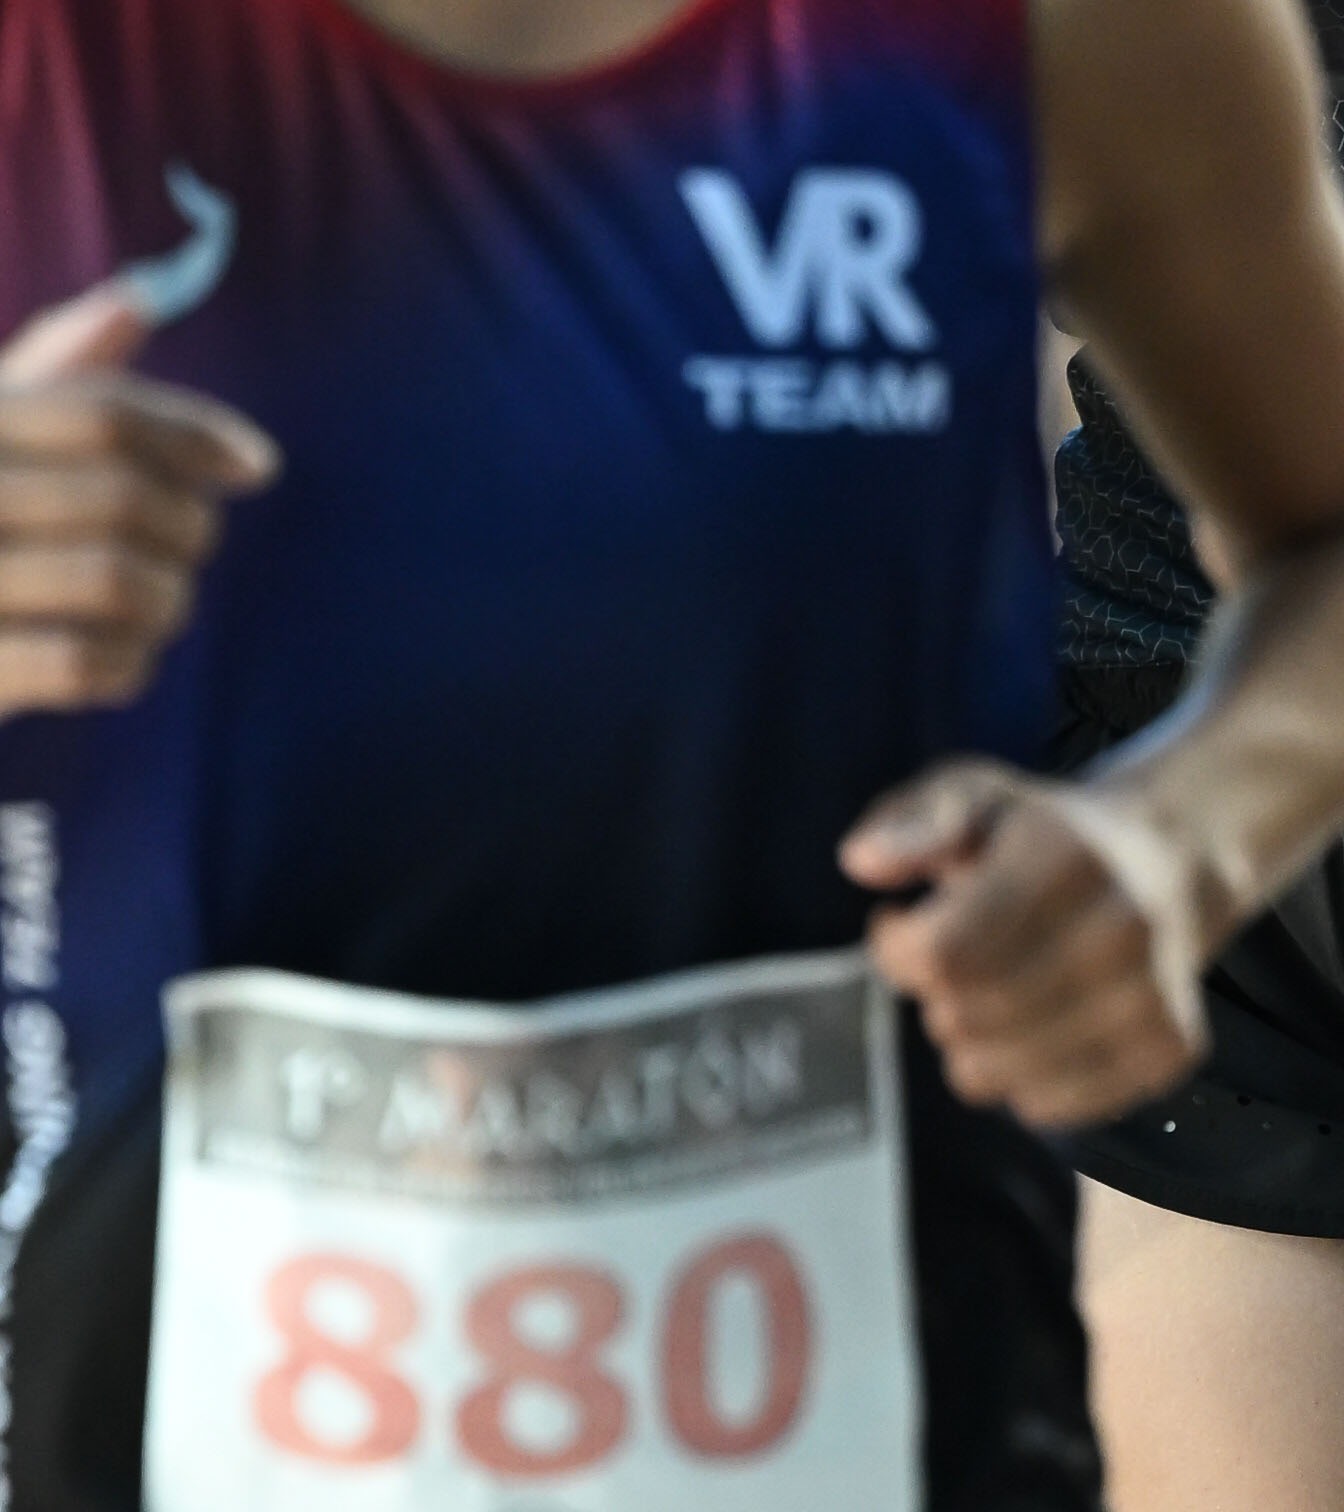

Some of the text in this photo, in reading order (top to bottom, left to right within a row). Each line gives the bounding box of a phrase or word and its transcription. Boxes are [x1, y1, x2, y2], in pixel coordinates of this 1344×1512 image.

[676, 166, 939, 352] VR
[681, 354, 952, 434] TEAM
[376, 1018, 802, 1161] MARATÓN
[248, 1228, 816, 1489] 880
